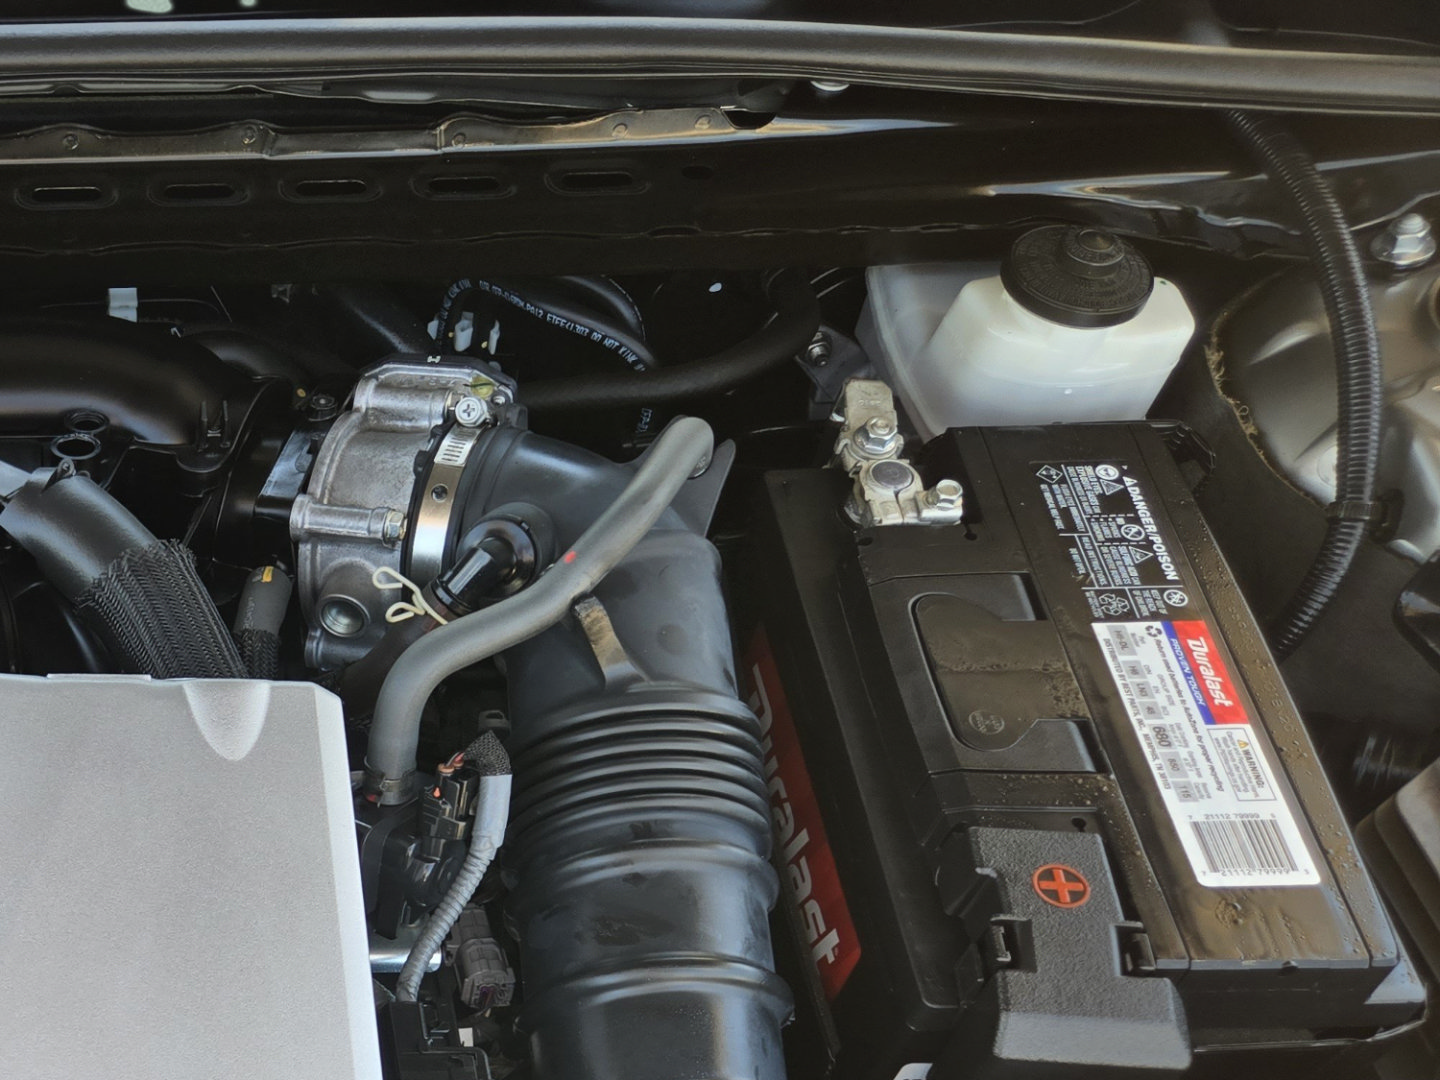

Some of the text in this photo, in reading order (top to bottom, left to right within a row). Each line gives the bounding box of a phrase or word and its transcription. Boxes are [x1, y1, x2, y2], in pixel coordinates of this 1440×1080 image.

[603, 337, 619, 350] NOT
[618, 346, 639, 365] KINK
[1126, 487, 1179, 579] DANGER/POISON
[1101, 638, 1123, 672] DISTRIBUTED
[1152, 638, 1168, 657] Return
[1161, 658, 1174, 672] used
[1169, 638, 1206, 706] PROVEN TOUGH
[1184, 636, 1234, 706] Duralast
[1116, 673, 1127, 681] BY
[1167, 673, 1185, 698] batteries
[1120, 682, 1133, 696] BEST
[1181, 706, 1201, 733] AutoZone
[1150, 726, 1172, 746] 680
[1193, 734, 1204, 742] for
[1196, 744, 1213, 763] proper
[1153, 762, 1164, 771] TN
[1205, 764, 1225, 791] recycling
[1240, 749, 1266, 788] WARNING:
[1178, 785, 1192, 798] 115
